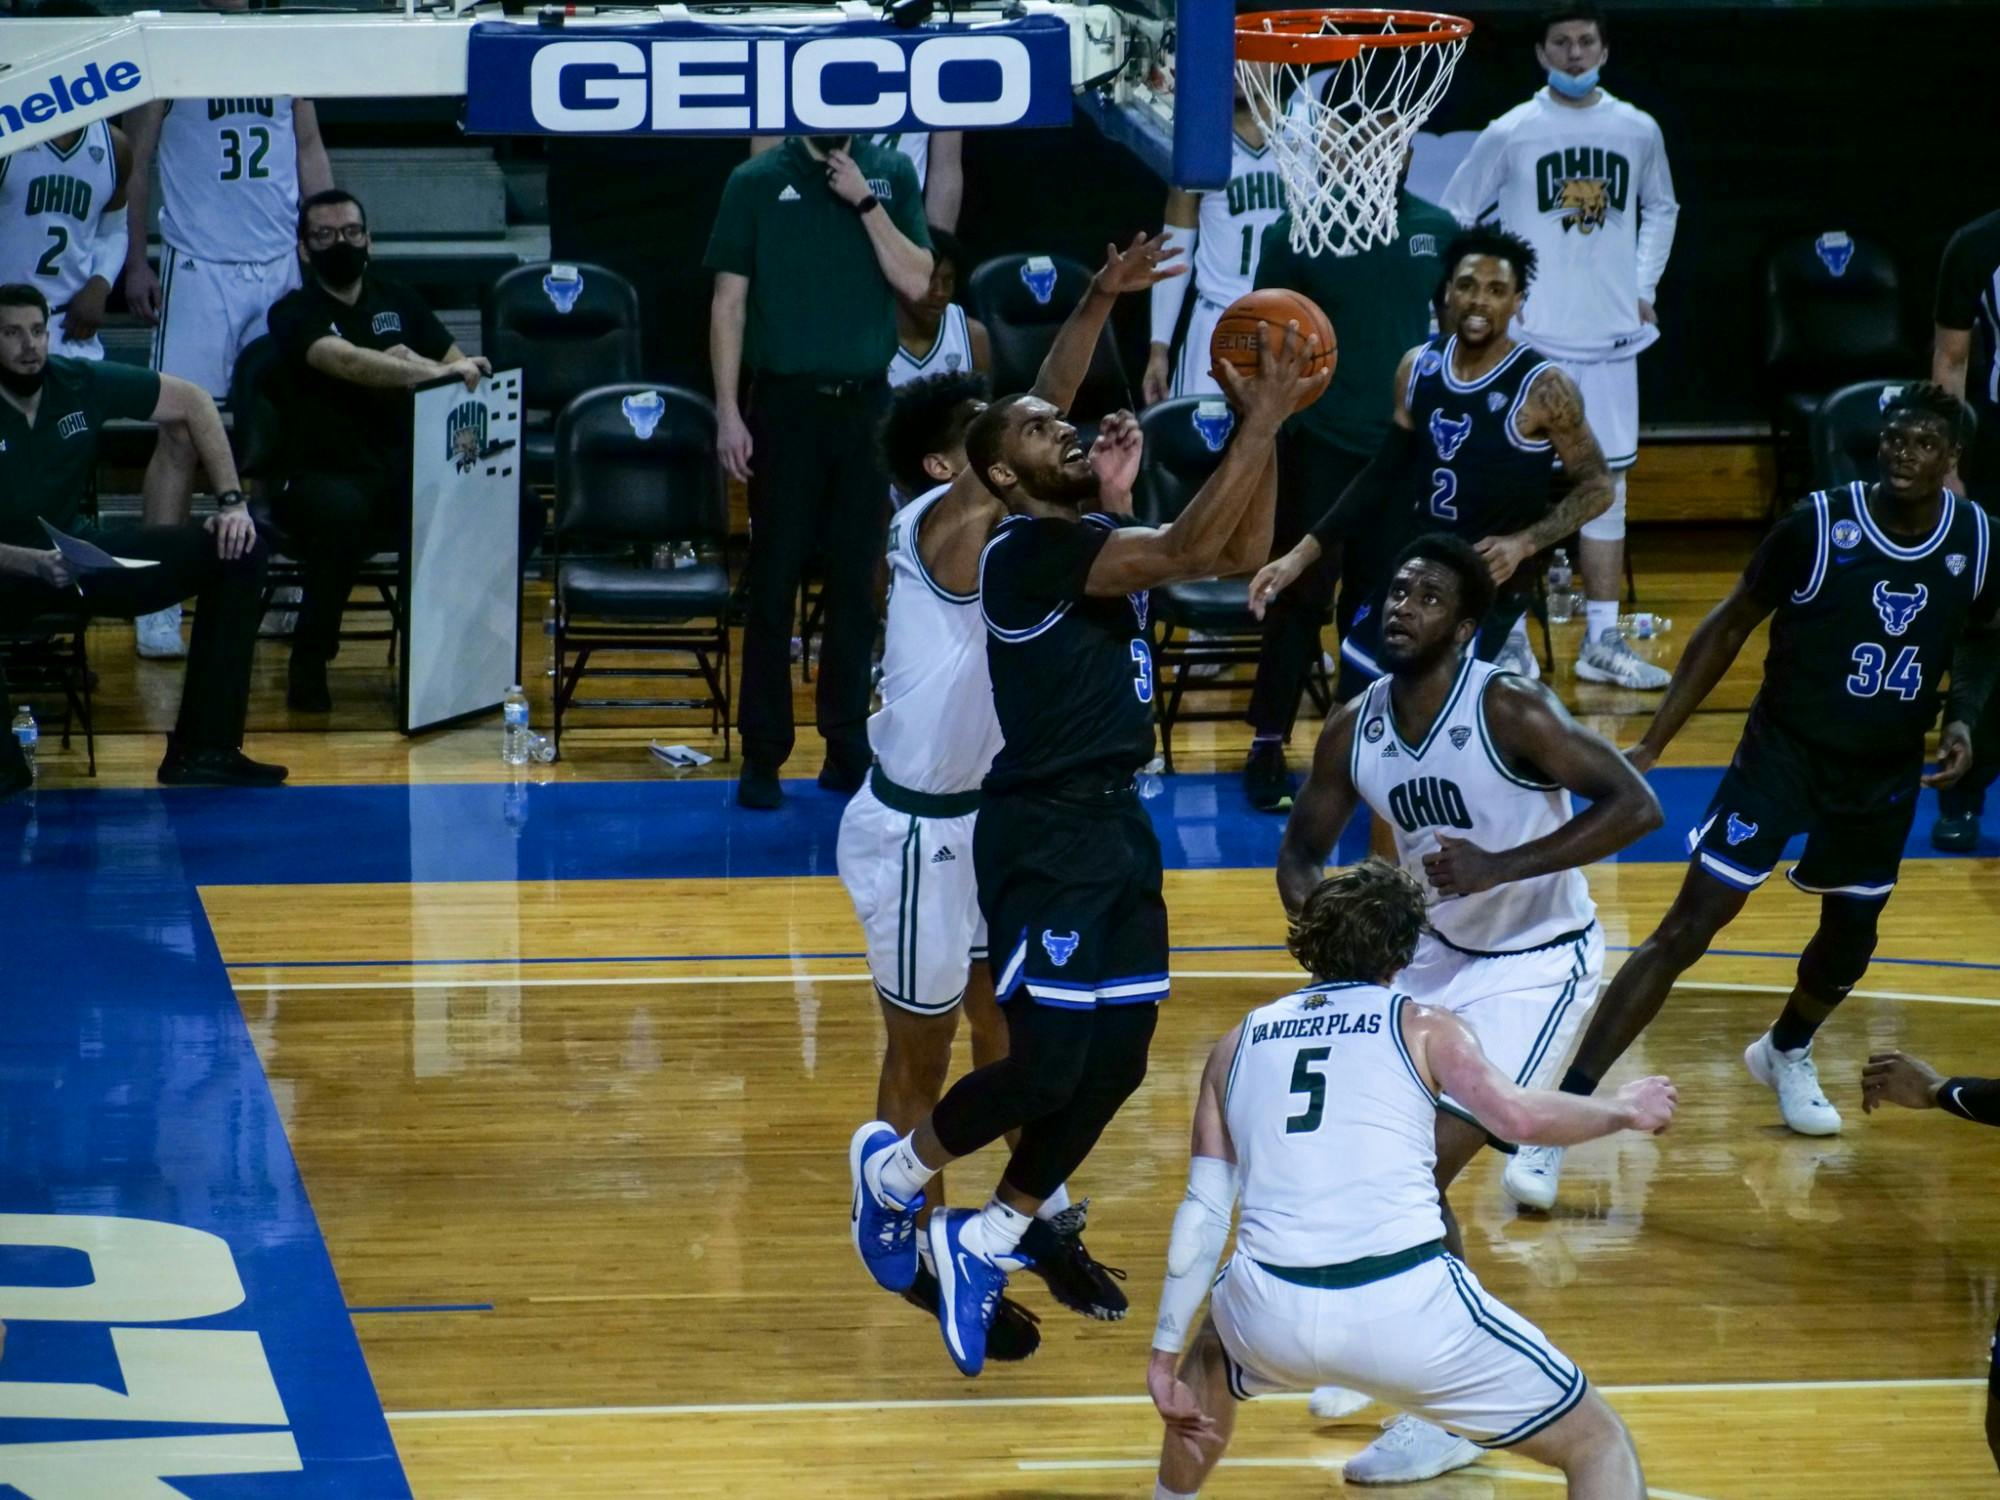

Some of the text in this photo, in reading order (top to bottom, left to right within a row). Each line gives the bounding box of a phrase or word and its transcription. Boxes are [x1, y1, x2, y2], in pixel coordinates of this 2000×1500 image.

[530, 36, 1031, 132] GEICO
[220, 126, 270, 180] 32
[1536, 146, 1630, 213] OHIO
[25, 174, 92, 222] OHIO
[36, 225, 68, 275] 2
[371, 311, 401, 335] OHIO
[446, 400, 488, 461] OHIO
[1430, 467, 1458, 521] 2
[1130, 638, 1153, 703] 3
[1847, 642, 1923, 701] 34
[1388, 776, 1473, 832] OHIO
[1286, 1046, 1332, 1134] 5
